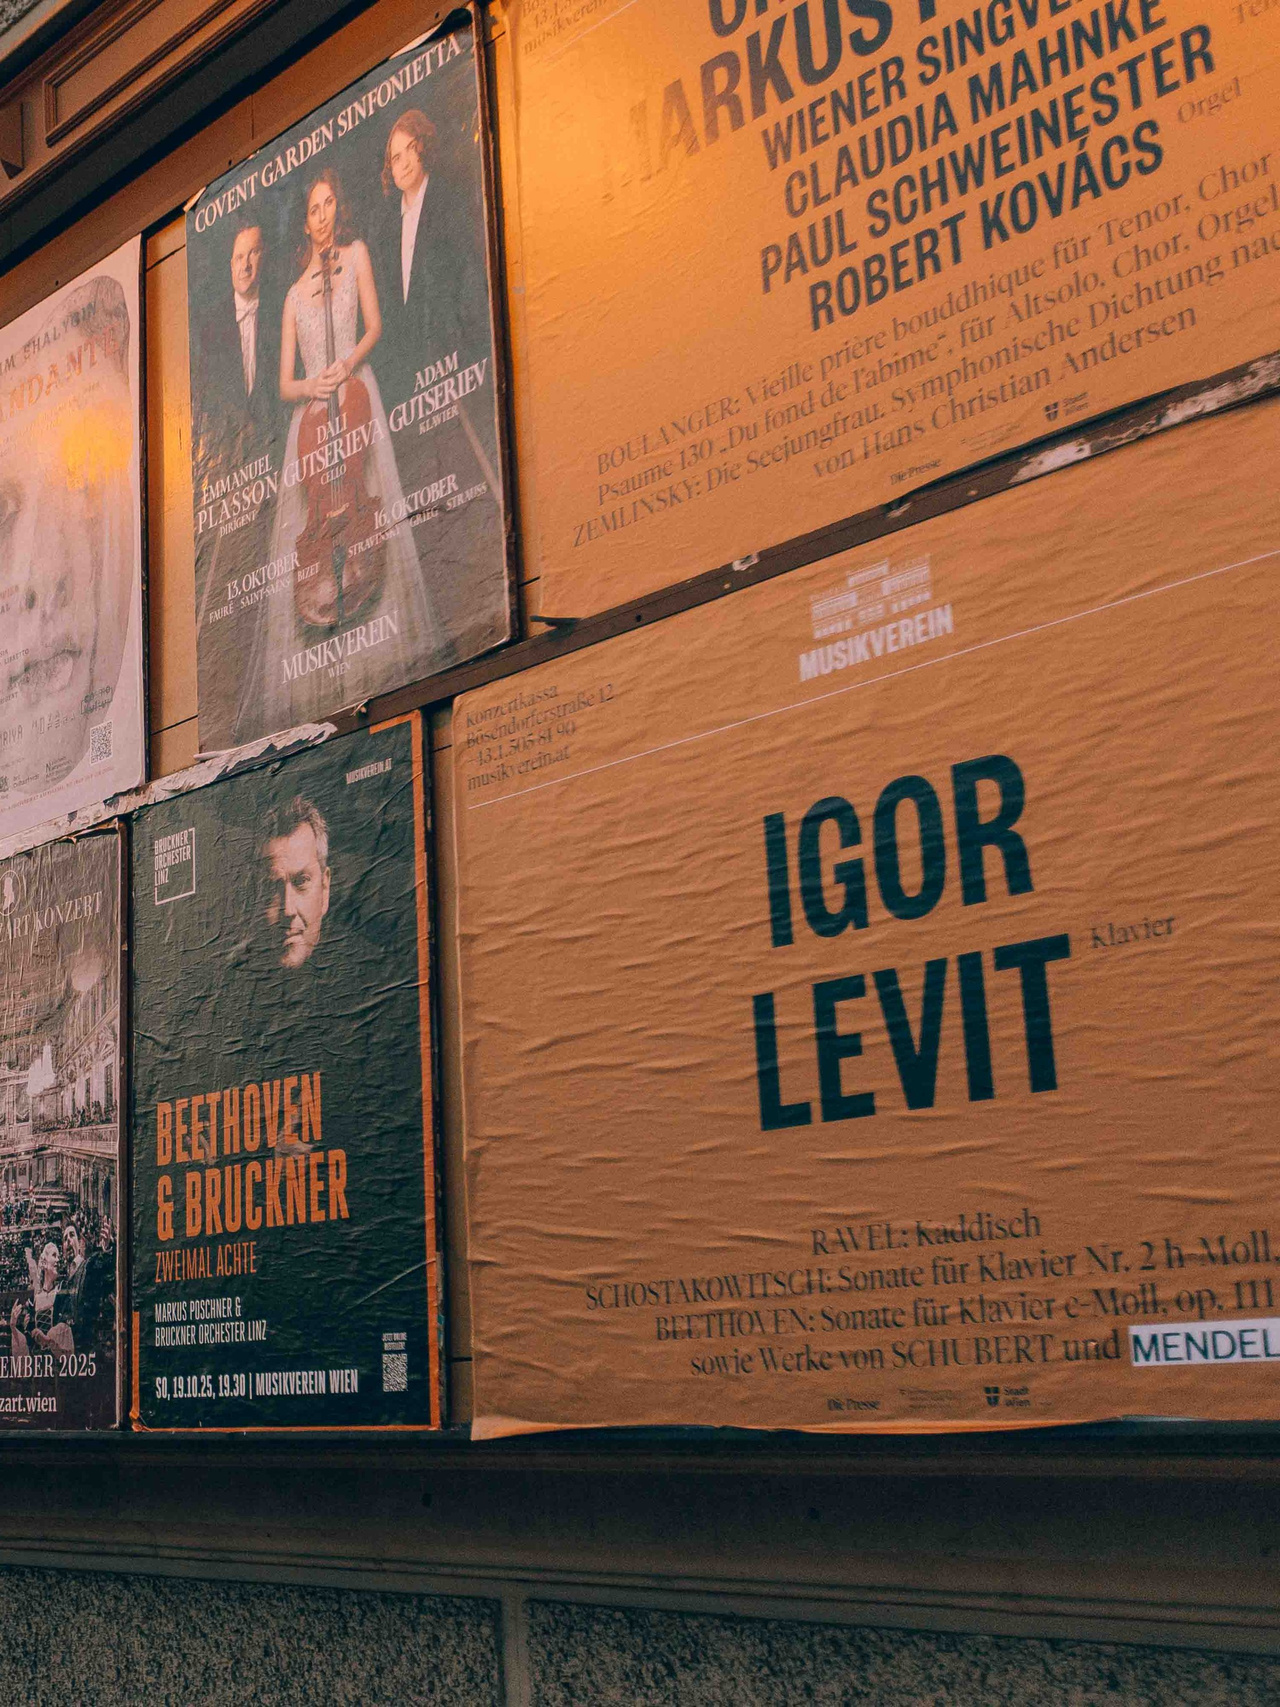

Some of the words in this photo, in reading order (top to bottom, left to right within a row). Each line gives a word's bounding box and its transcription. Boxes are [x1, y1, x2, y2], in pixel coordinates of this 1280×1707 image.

[194, 171, 258, 233] COVENT
[261, 120, 333, 187] GARDEN
[337, 32, 461, 138] SINFONIETTA
[762, 56, 907, 172] WIENER
[785, 91, 959, 218] CLAUDIA
[968, 0, 1167, 125] MAHNKE
[760, 209, 857, 294] PAUL
[867, 23, 1216, 239] SCHWEINESTER
[1176, 76, 1242, 124] Orgel
[808, 210, 966, 332] ROBERT
[979, 118, 1165, 251] KOVÁCS
[596, 396, 740, 476] BOULANGER:
[745, 361, 813, 407] Vieille
[820, 327, 886, 376] prière
[892, 258, 1045, 342] bouddhique
[1052, 233, 1093, 270] für
[1198, 151, 1273, 201] Chor
[389, 358, 488, 433] GUTSERIEV
[413, 351, 460, 393] ADAM
[812, 449, 854, 478] von
[862, 421, 926, 461] Hans
[931, 365, 1051, 430] Christian
[1059, 306, 1198, 381] Andersen
[316, 412, 348, 445] DALI
[572, 477, 701, 547] ZEMLINSKY:
[706, 462, 741, 493] Die
[891, 313, 1080, 413] Symphonische
[1087, 256, 1225, 329] Dichtung
[597, 456, 674, 505] Psaume
[679, 438, 714, 472] 130
[764, 390, 816, 434] fond
[820, 379, 848, 409] de
[959, 312, 996, 347] für
[201, 454, 272, 506] EMMANUEL
[283, 418, 384, 488] GUTSERIEVA
[320, 464, 347, 486] CELLO
[197, 470, 281, 534] PLASSON
[219, 508, 258, 538] DIRIGENT
[373, 509, 391, 530] 16.
[391, 472, 459, 519] OKTOBER
[226, 581, 241, 600] 13.
[241, 551, 300, 593] OKTOBER
[297, 562, 320, 582] BIZET
[281, 611, 398, 685] MUSIKVEREIN
[799, 602, 953, 682] MUSIKVEREIN
[154, 830, 188, 856] BRUCKNER
[154, 845, 191, 870] ORCHESTER
[763, 753, 1034, 948] IGOR
[154, 868, 168, 886] LINZ
[35, 891, 102, 933] KONZERT
[752, 933, 1071, 1131] LEVIT
[1090, 915, 1176, 950] Klavier
[156, 1071, 322, 1167] BEETHOVEN
[157, 1175, 175, 1242] &
[185, 1148, 349, 1238] BRUCKNER
[155, 1245, 213, 1284] ZWEIMAL
[216, 1241, 258, 1277] ACHTE
[811, 1222, 908, 1256] RAVEL:
[586, 1268, 832, 1311] SCHOSTAKOWITSCH:
[838, 1262, 925, 1292] Sonate
[932, 1256, 970, 1286] für
[978, 1249, 1077, 1284] Klavier
[1084, 1246, 1131, 1275] Nr.
[1140, 1241, 1156, 1272] 2
[155, 1300, 187, 1323] MARKUS
[189, 1297, 233, 1321] POSCHNER
[235, 1296, 242, 1317] &
[155, 1323, 197, 1347] BRUCKNER
[198, 1321, 246, 1345] ORCHESTER
[248, 1319, 267, 1341] LINZ
[655, 1306, 815, 1341] BEETHOVEN:
[820, 1304, 906, 1333] Sonate
[913, 1297, 950, 1327] für
[959, 1292, 1057, 1325] Klavier
[1174, 1288, 1224, 1320] op.
[59, 1353, 97, 1377] 2025
[690, 1348, 755, 1377] sowie
[758, 1344, 832, 1373] Werke
[836, 1350, 885, 1370] von
[891, 1333, 1057, 1370] SCHUBERT
[1064, 1329, 1122, 1361] und
[1132, 1327, 1280, 1364] MENDEL
[155, 1376, 170, 1401] SO,
[172, 1374, 216, 1399] 19.10.25,
[218, 1373, 246, 1397] 19.30
[255, 1370, 326, 1397] MUSIKVEREIN
[329, 1369, 359, 1394] WIEN
